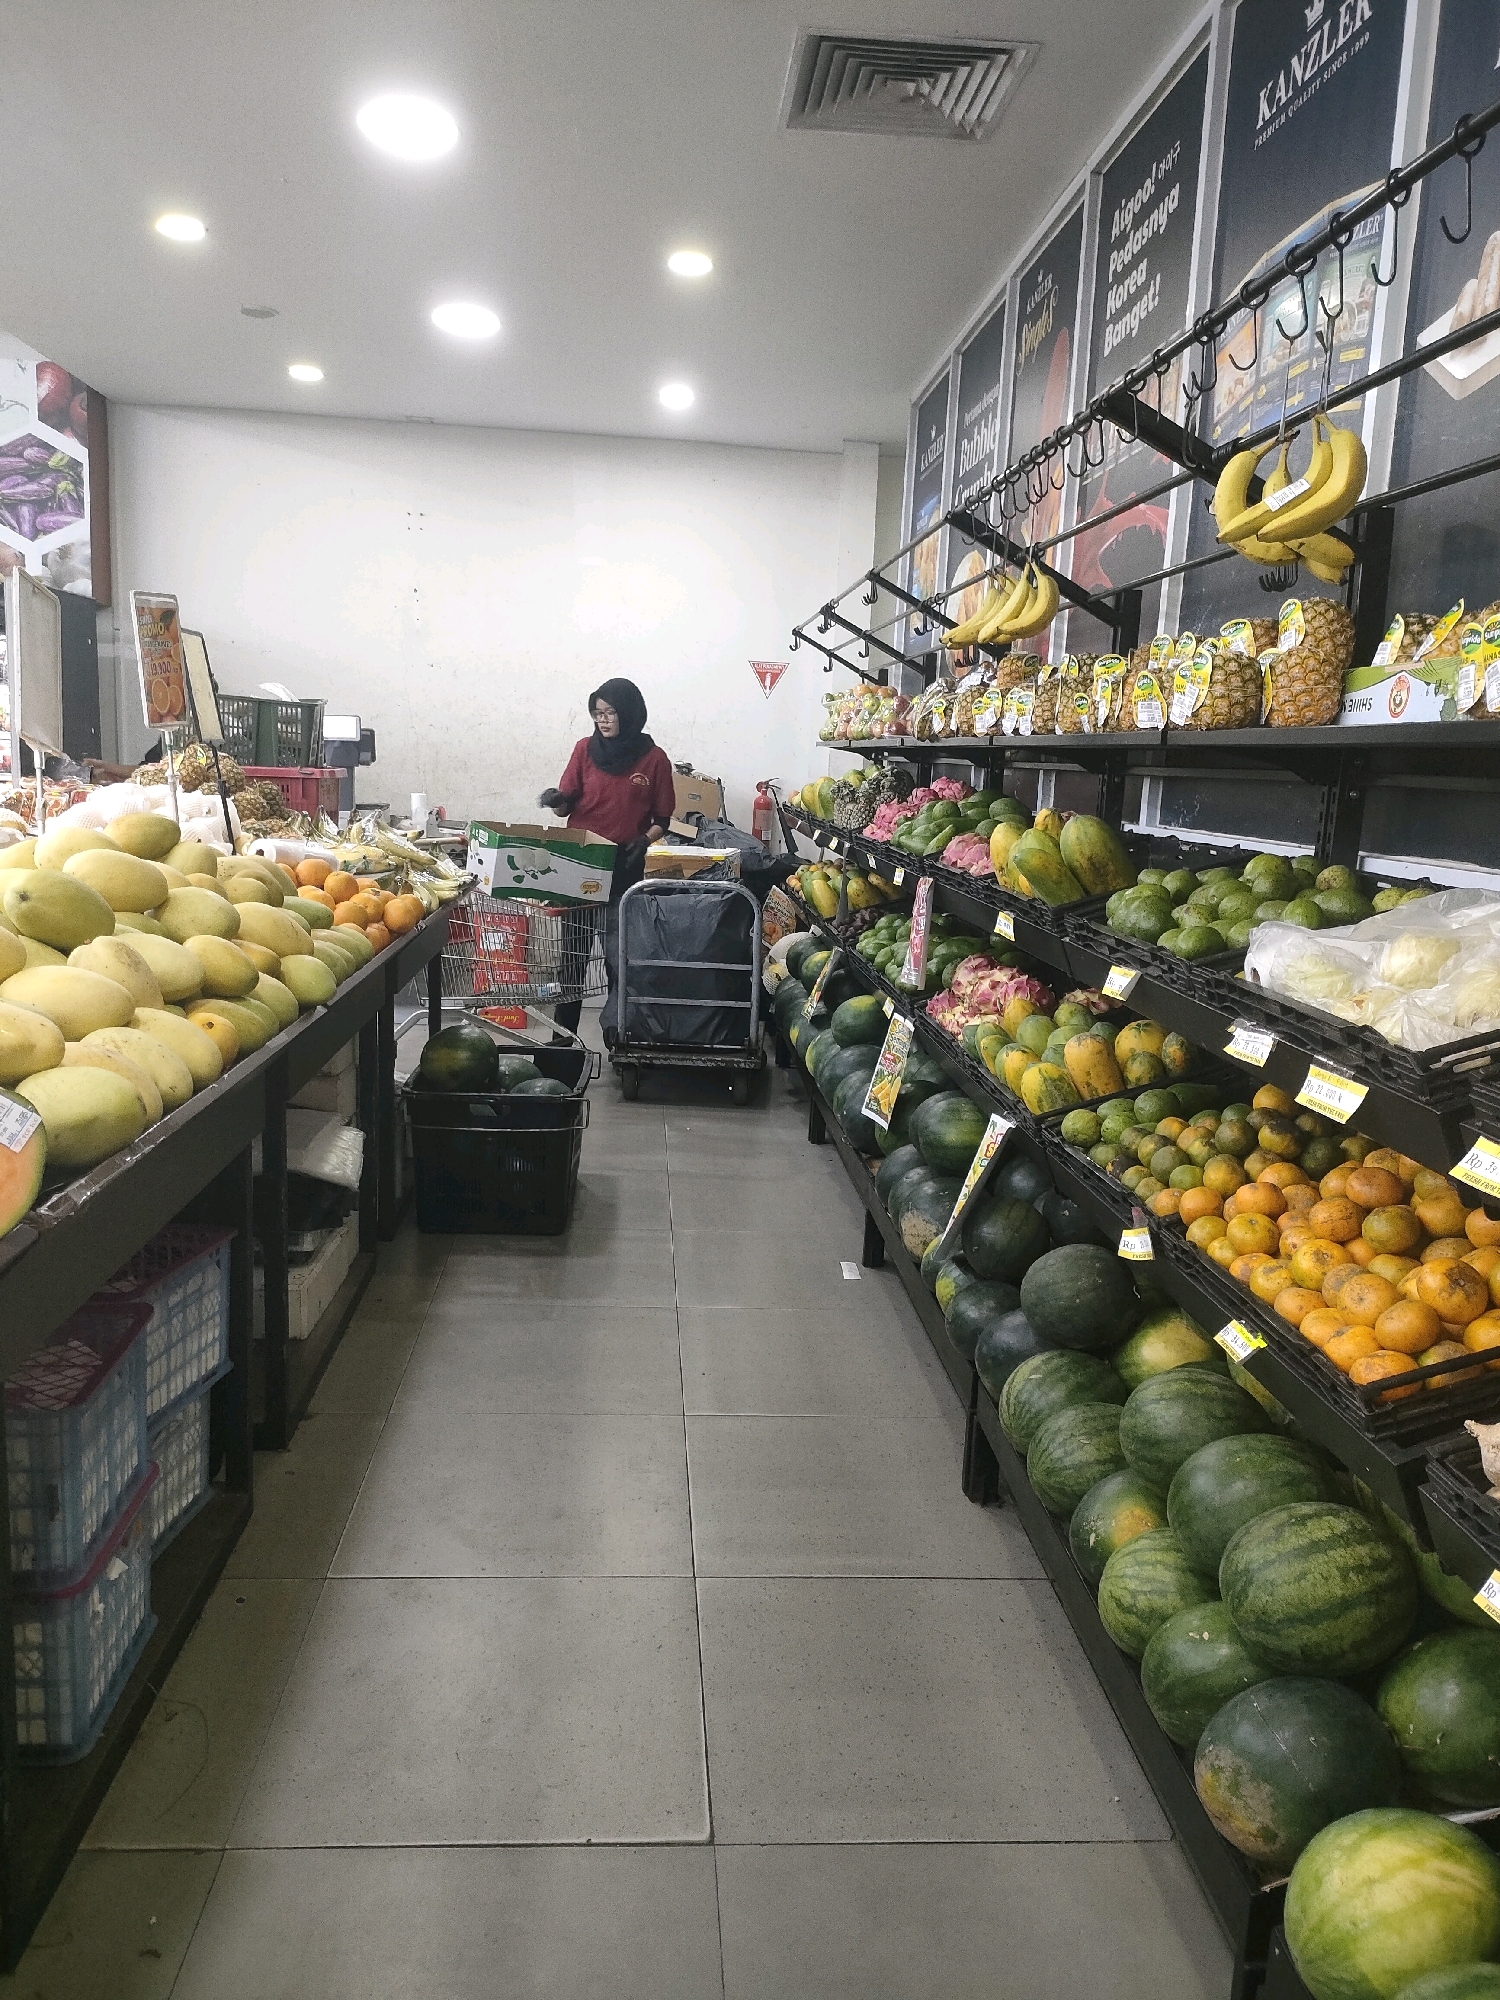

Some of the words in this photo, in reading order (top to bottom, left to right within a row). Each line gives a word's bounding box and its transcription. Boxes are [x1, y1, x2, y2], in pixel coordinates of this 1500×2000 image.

[1256, 0, 1373, 131] KANZLER
[1253, 112, 1286, 151] PREMIUM
[1287, 77, 1322, 118] QUALITY
[1322, 51, 1348, 83] SINCE
[1350, 31, 1370, 56] 1999
[1111, 161, 1157, 243] Aigoo!
[1108, 182, 1180, 283] Pedasnya
[1026, 273, 1053, 315] KANZLER
[1106, 258, 1148, 320] Korea
[1103, 273, 1161, 358] Banget!
[920, 432, 946, 473] KANZLER
[1304, 1079, 1314, 1094] Rp
[1462, 1172, 1482, 1186] FRESH
[1465, 1153, 1483, 1170] Rp
[1122, 1240, 1136, 1251] Rp
[1483, 1582, 1497, 1599] Rp
